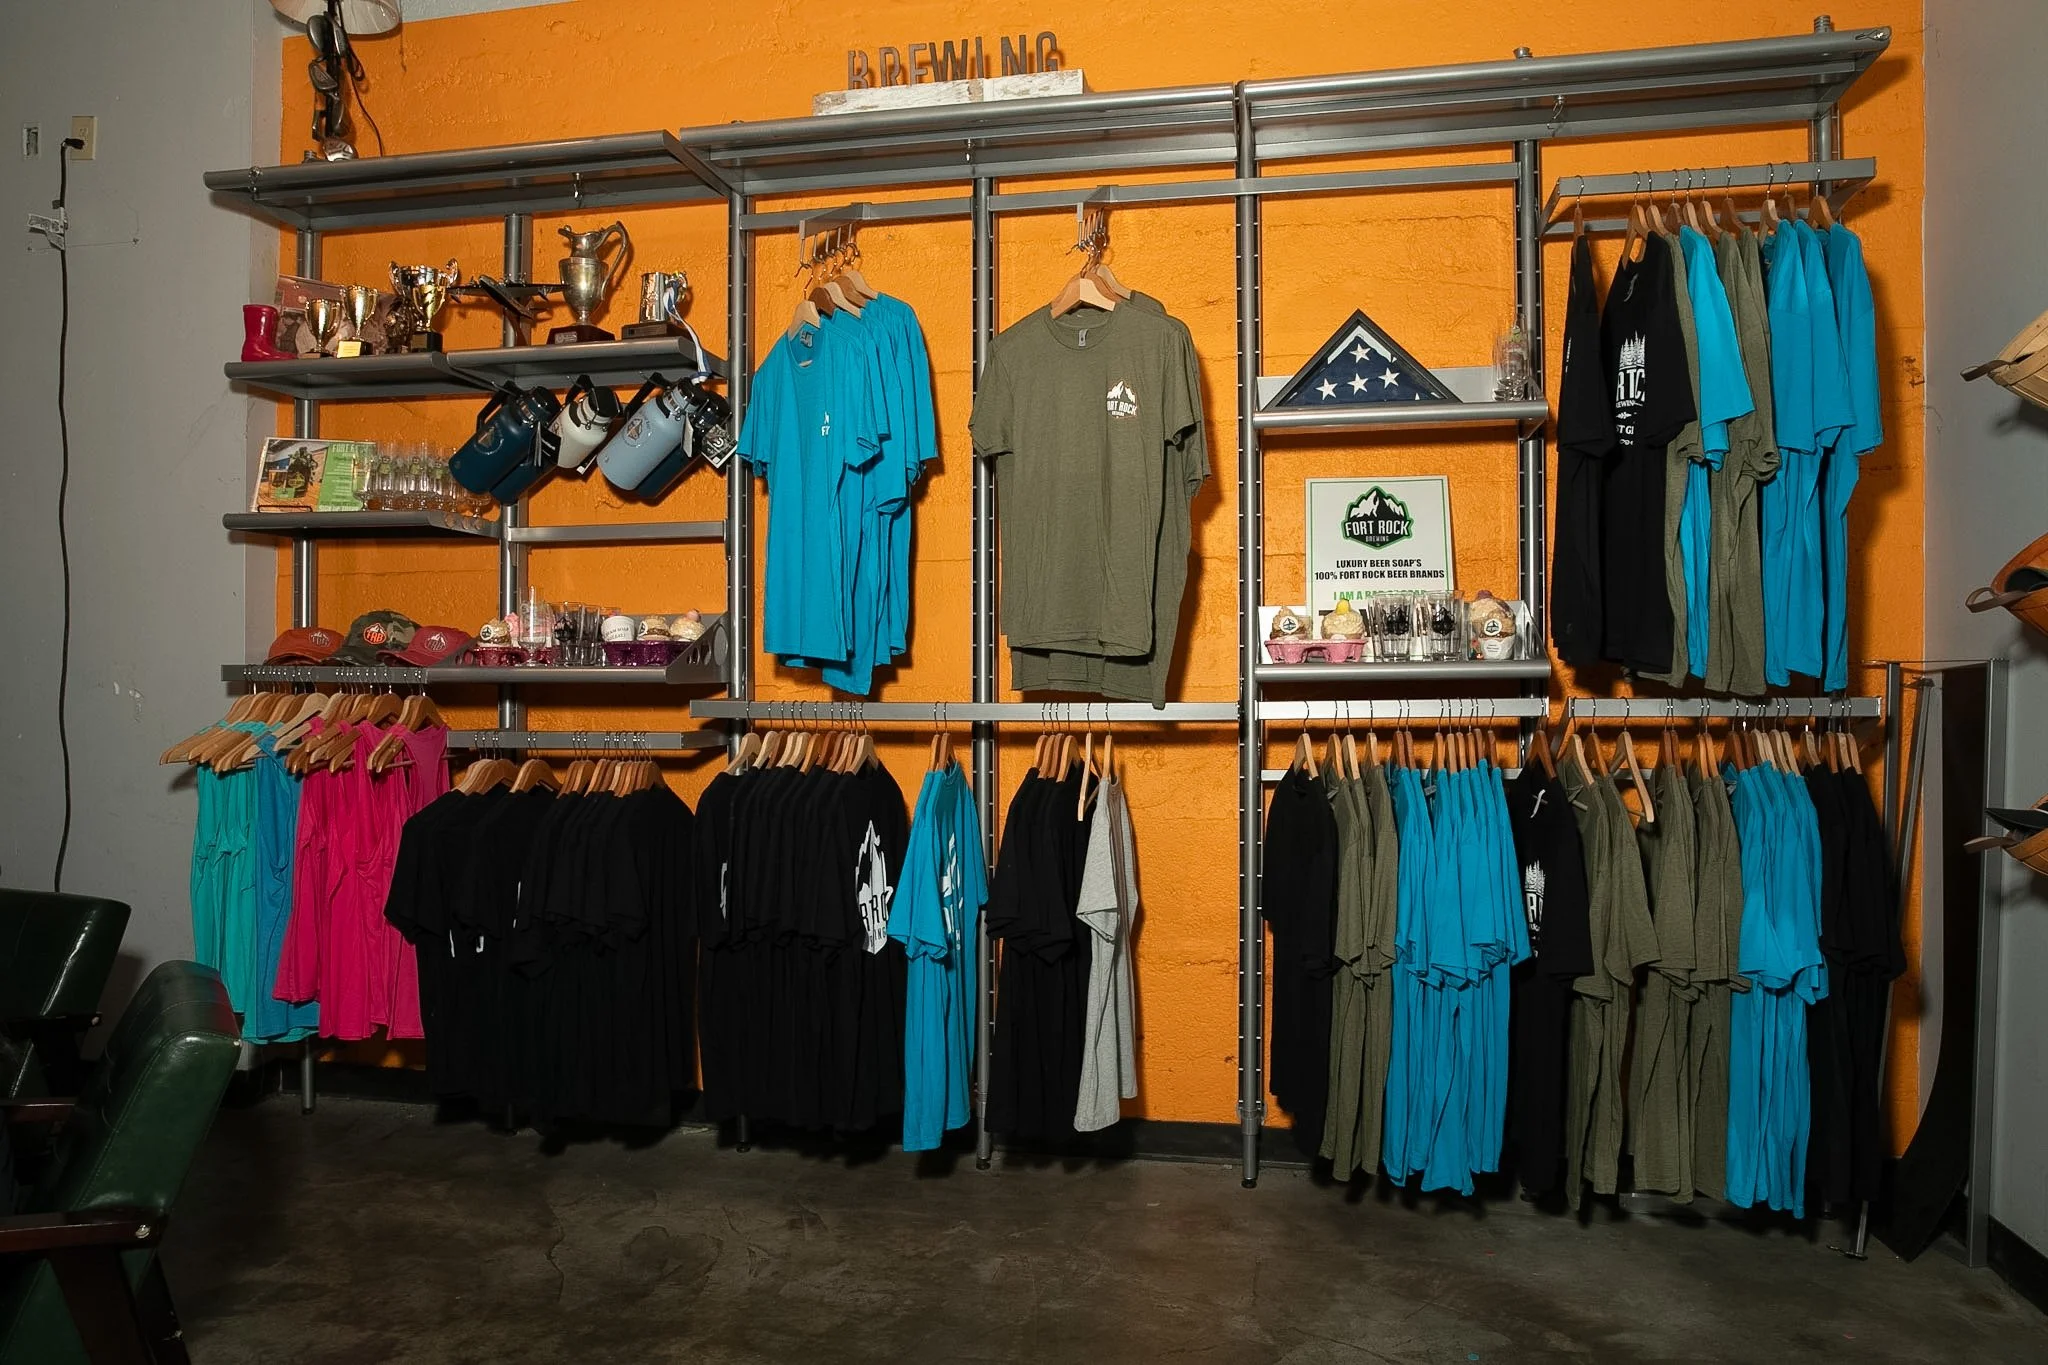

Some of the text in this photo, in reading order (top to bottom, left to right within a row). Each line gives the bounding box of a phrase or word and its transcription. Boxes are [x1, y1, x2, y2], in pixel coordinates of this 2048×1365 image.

[847, 31, 1064, 91] BREWING
[1345, 520, 1410, 536] FORT ROCK
[1336, 558, 1422, 568] LUXURY BEER SOAP'S
[1315, 570, 1445, 580] 100% FORT ROCK BEER BRANDS
[1356, 591, 1363, 600] A
